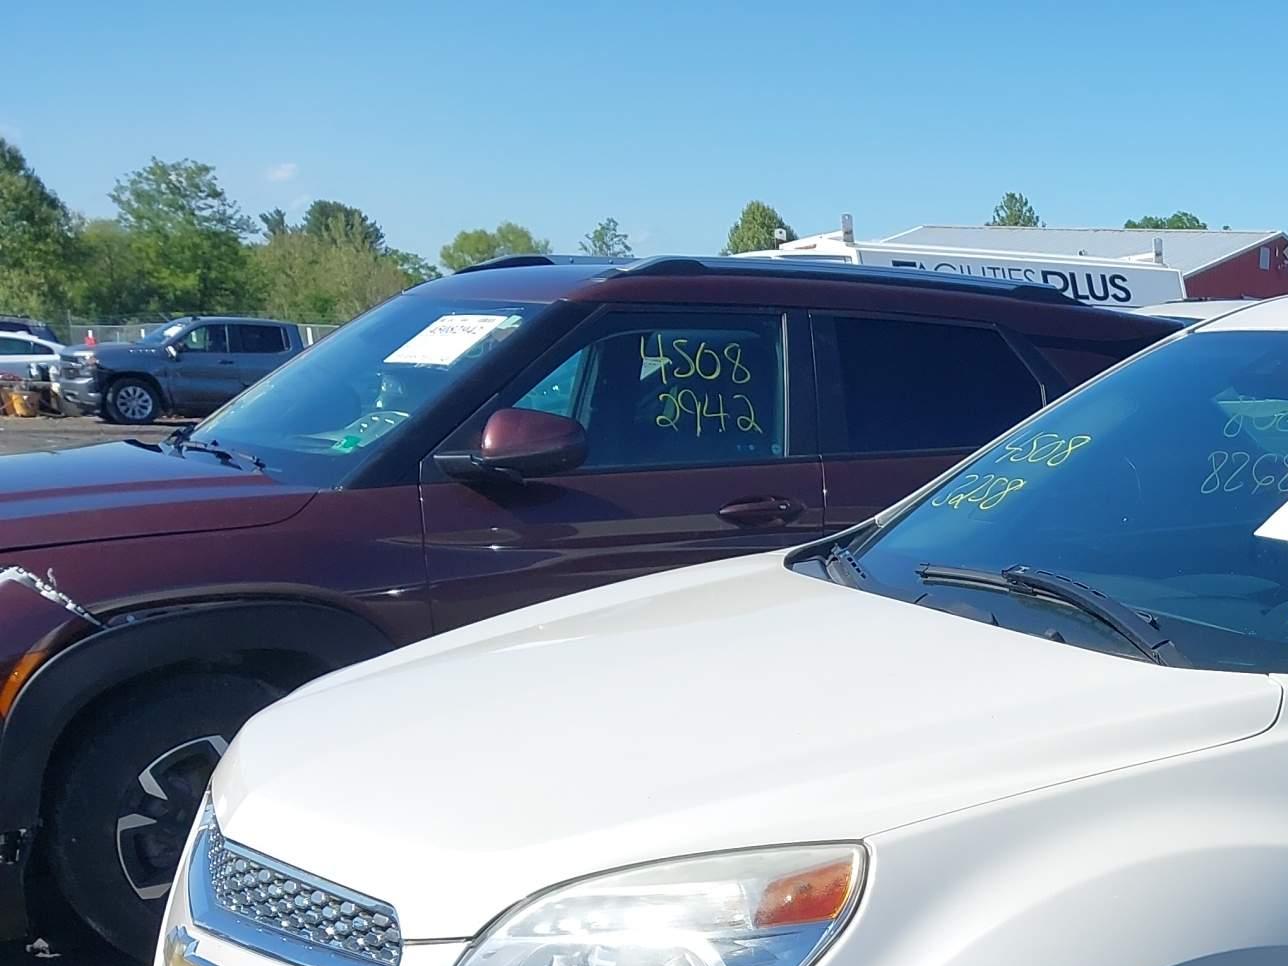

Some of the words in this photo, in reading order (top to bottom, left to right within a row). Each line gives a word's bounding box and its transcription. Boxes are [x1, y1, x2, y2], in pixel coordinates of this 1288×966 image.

[640, 334, 751, 384] 4508
[656, 388, 763, 437] 2942
[995, 431, 1093, 467] 4508
